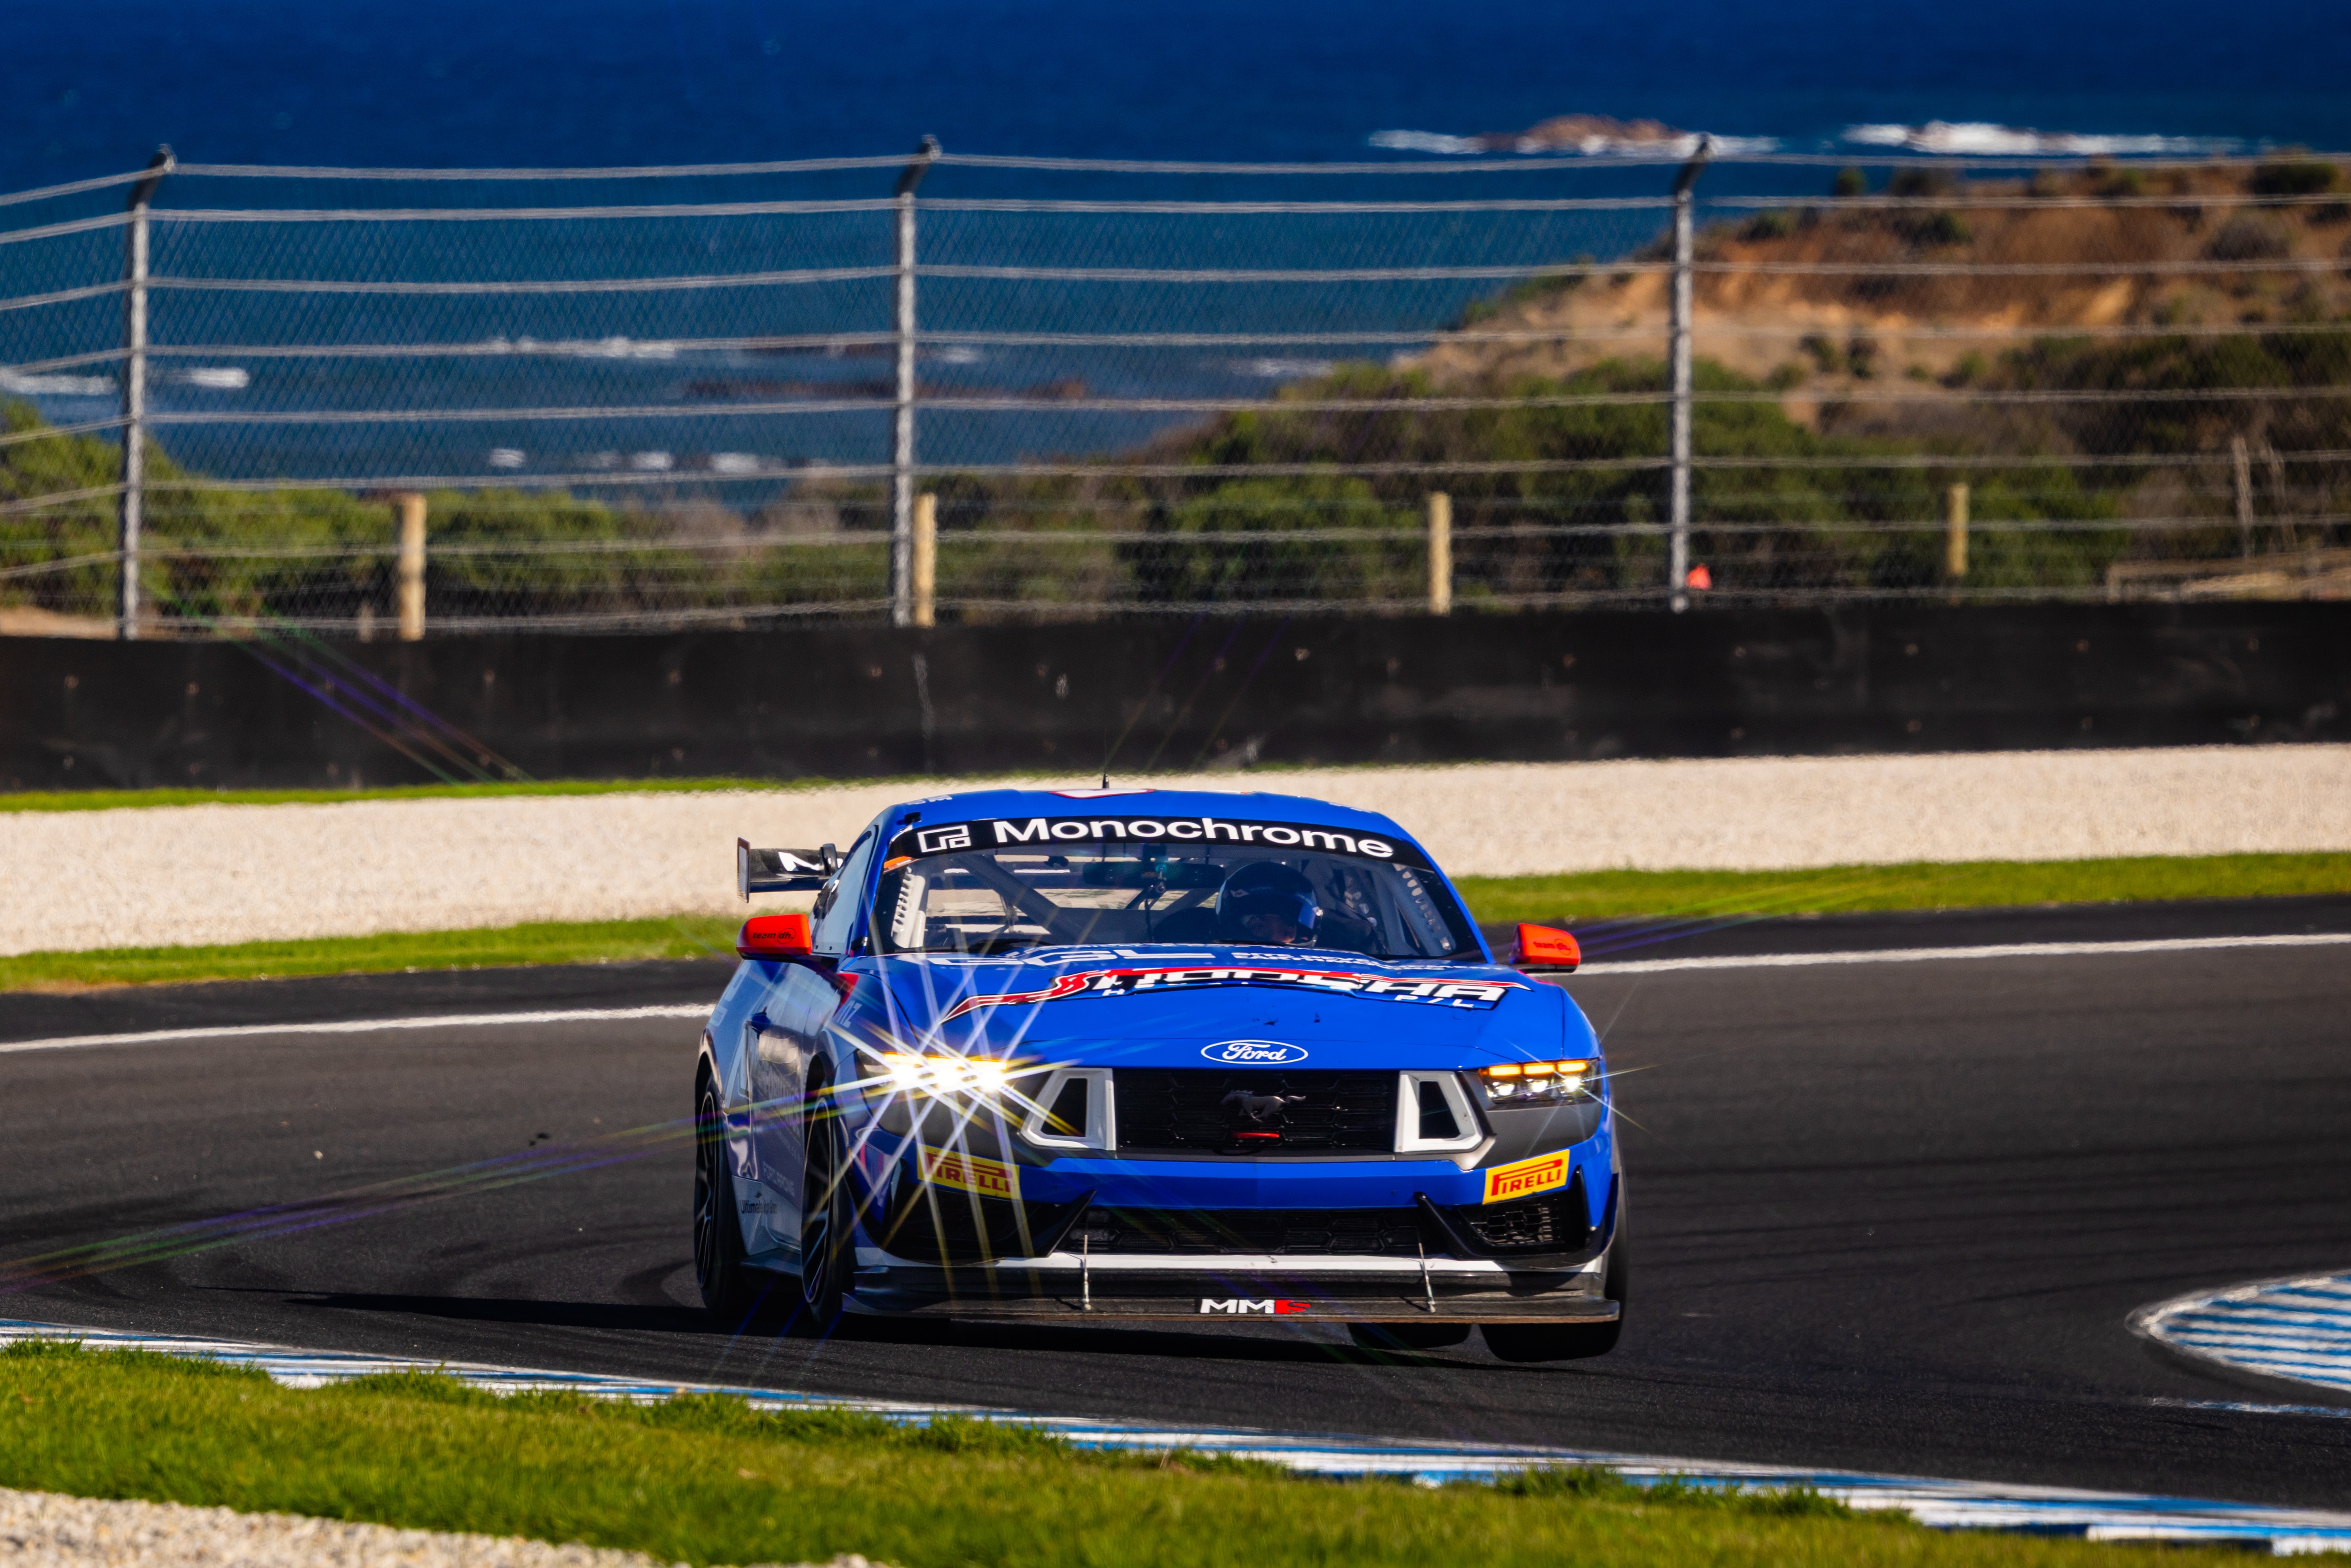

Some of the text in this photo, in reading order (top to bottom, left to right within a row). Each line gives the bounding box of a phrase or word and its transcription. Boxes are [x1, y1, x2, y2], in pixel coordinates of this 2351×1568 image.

[993, 818, 1393, 858] Monochrome
[1223, 1043, 1287, 1060] Ford
[924, 1152, 1012, 1193] PIRELLI
[1491, 1158, 1562, 1196] PIRELLI
